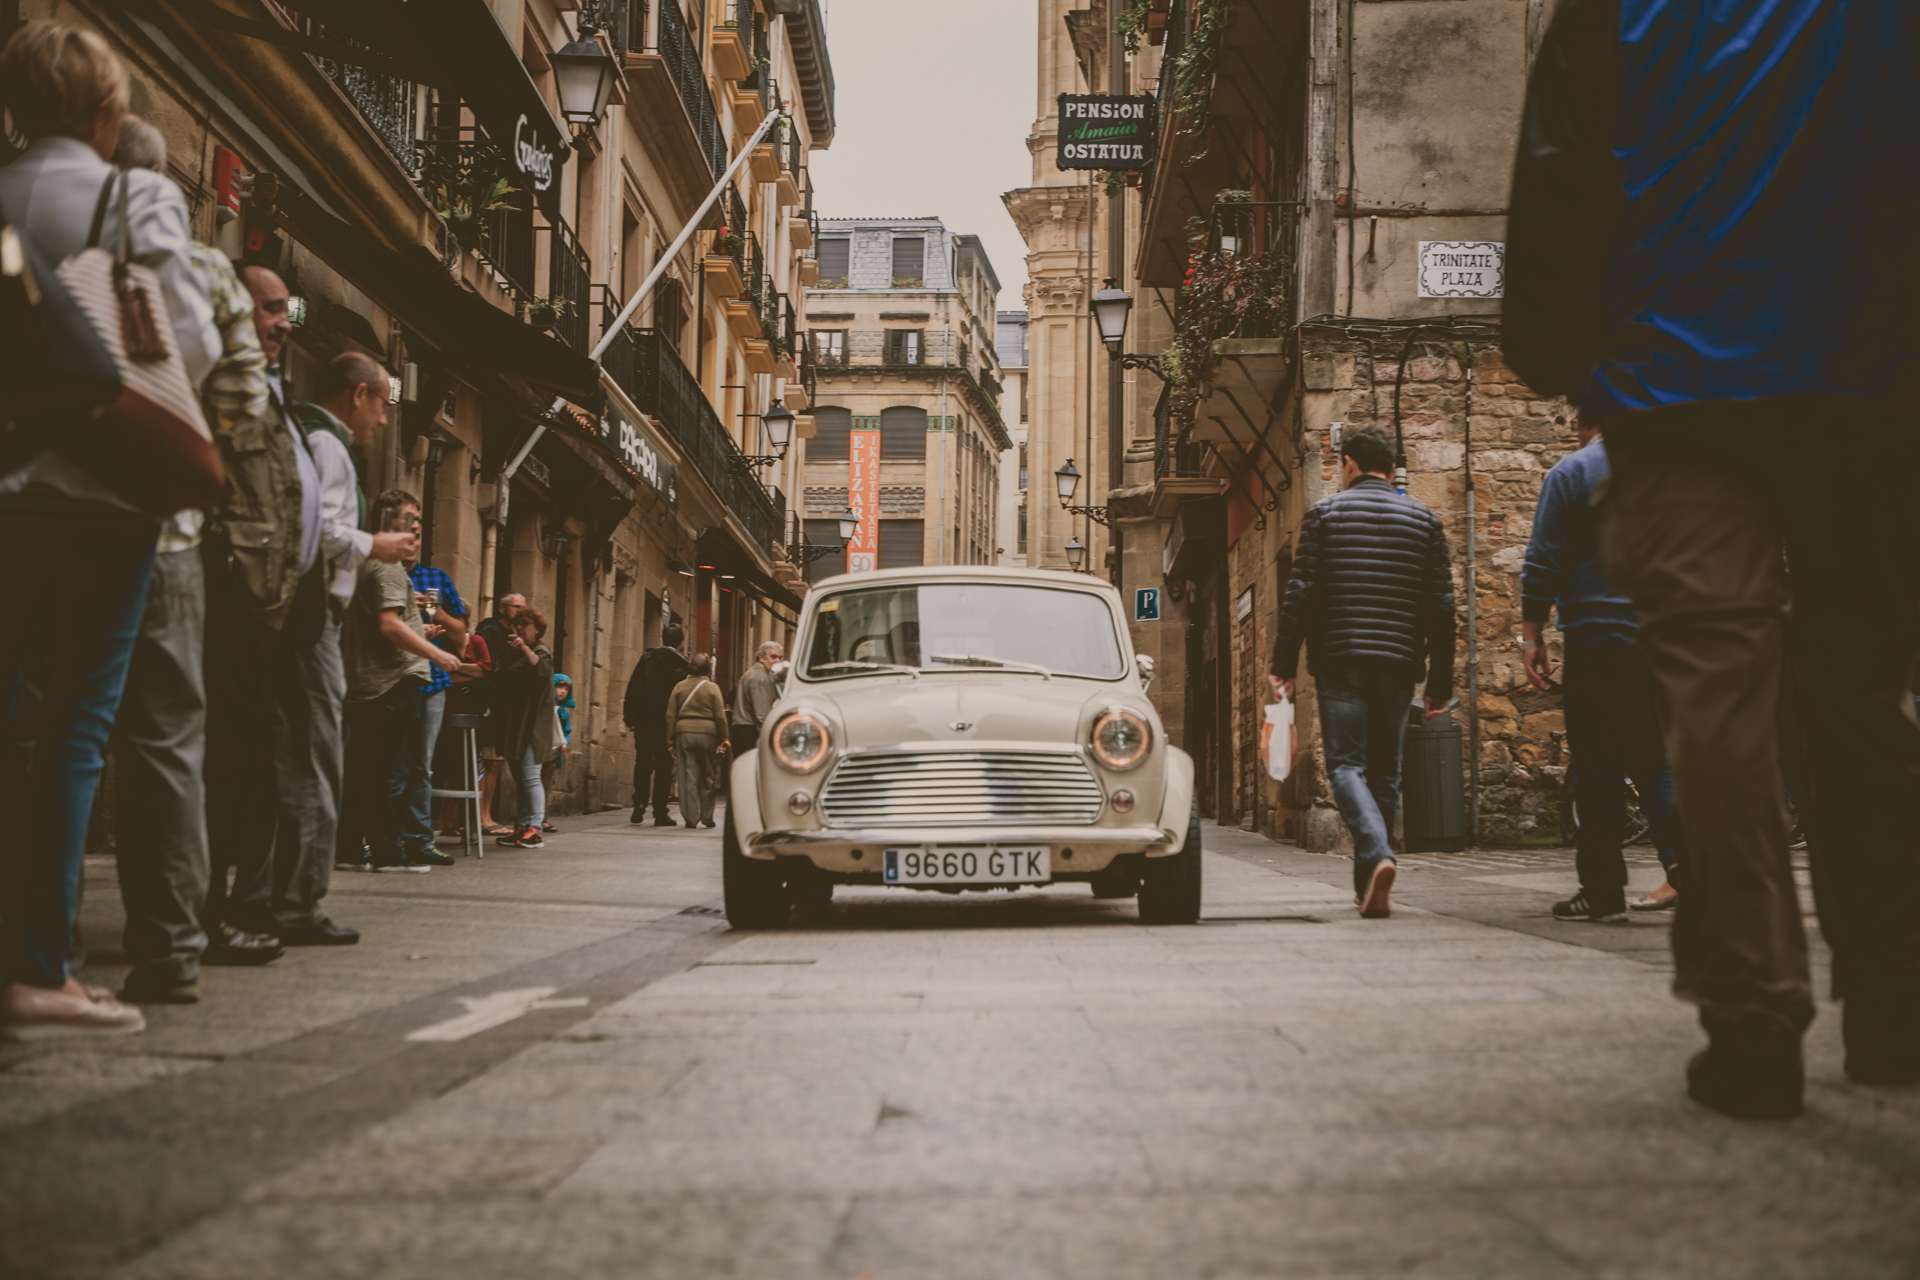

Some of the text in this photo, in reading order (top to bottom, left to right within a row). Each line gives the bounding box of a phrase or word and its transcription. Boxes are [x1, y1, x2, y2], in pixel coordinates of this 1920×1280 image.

[1067, 121, 1139, 141] Amaiur
[1063, 143, 1144, 160] OSTATUA
[1441, 272, 1483, 286] PLAZA
[619, 419, 658, 488] DAKARA
[850, 435, 865, 549] ELIZARAN
[867, 435, 878, 549] IKASTETXEA
[1143, 592, 1154, 609] P
[905, 852, 978, 878] 9660
[988, 851, 1043, 877] GTK
